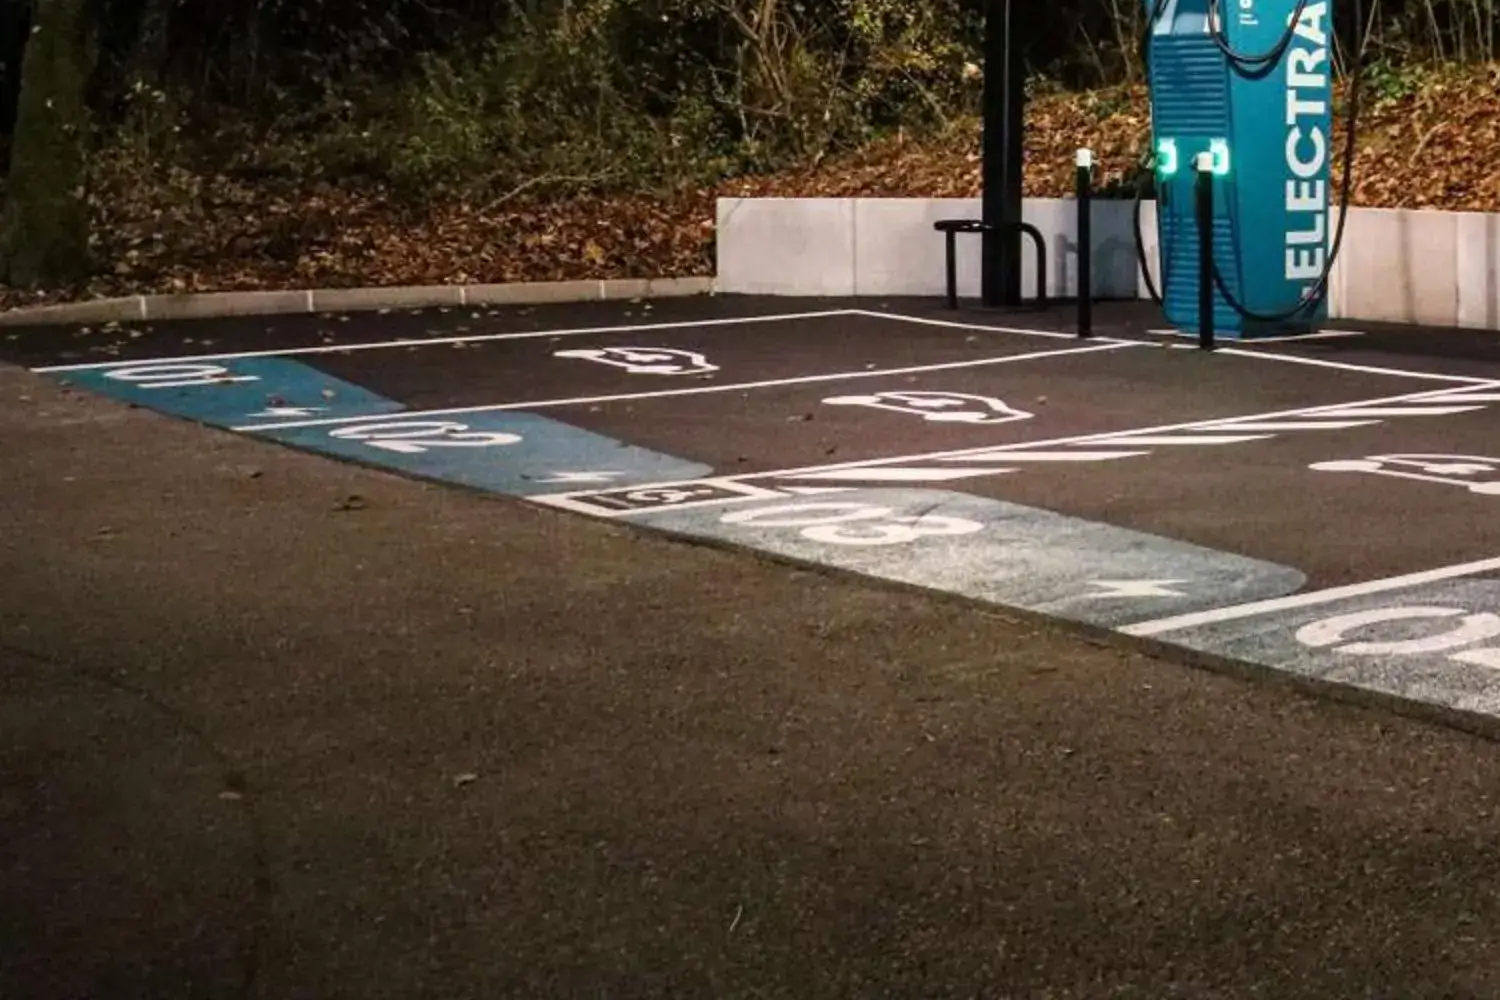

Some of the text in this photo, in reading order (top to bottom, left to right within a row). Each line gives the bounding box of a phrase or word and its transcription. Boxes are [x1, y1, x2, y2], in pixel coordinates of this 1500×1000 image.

[1285, 1, 1327, 280] ELECTRA
[104, 365, 262, 388] 01
[329, 421, 523, 453] 02
[719, 503, 984, 545] 03
